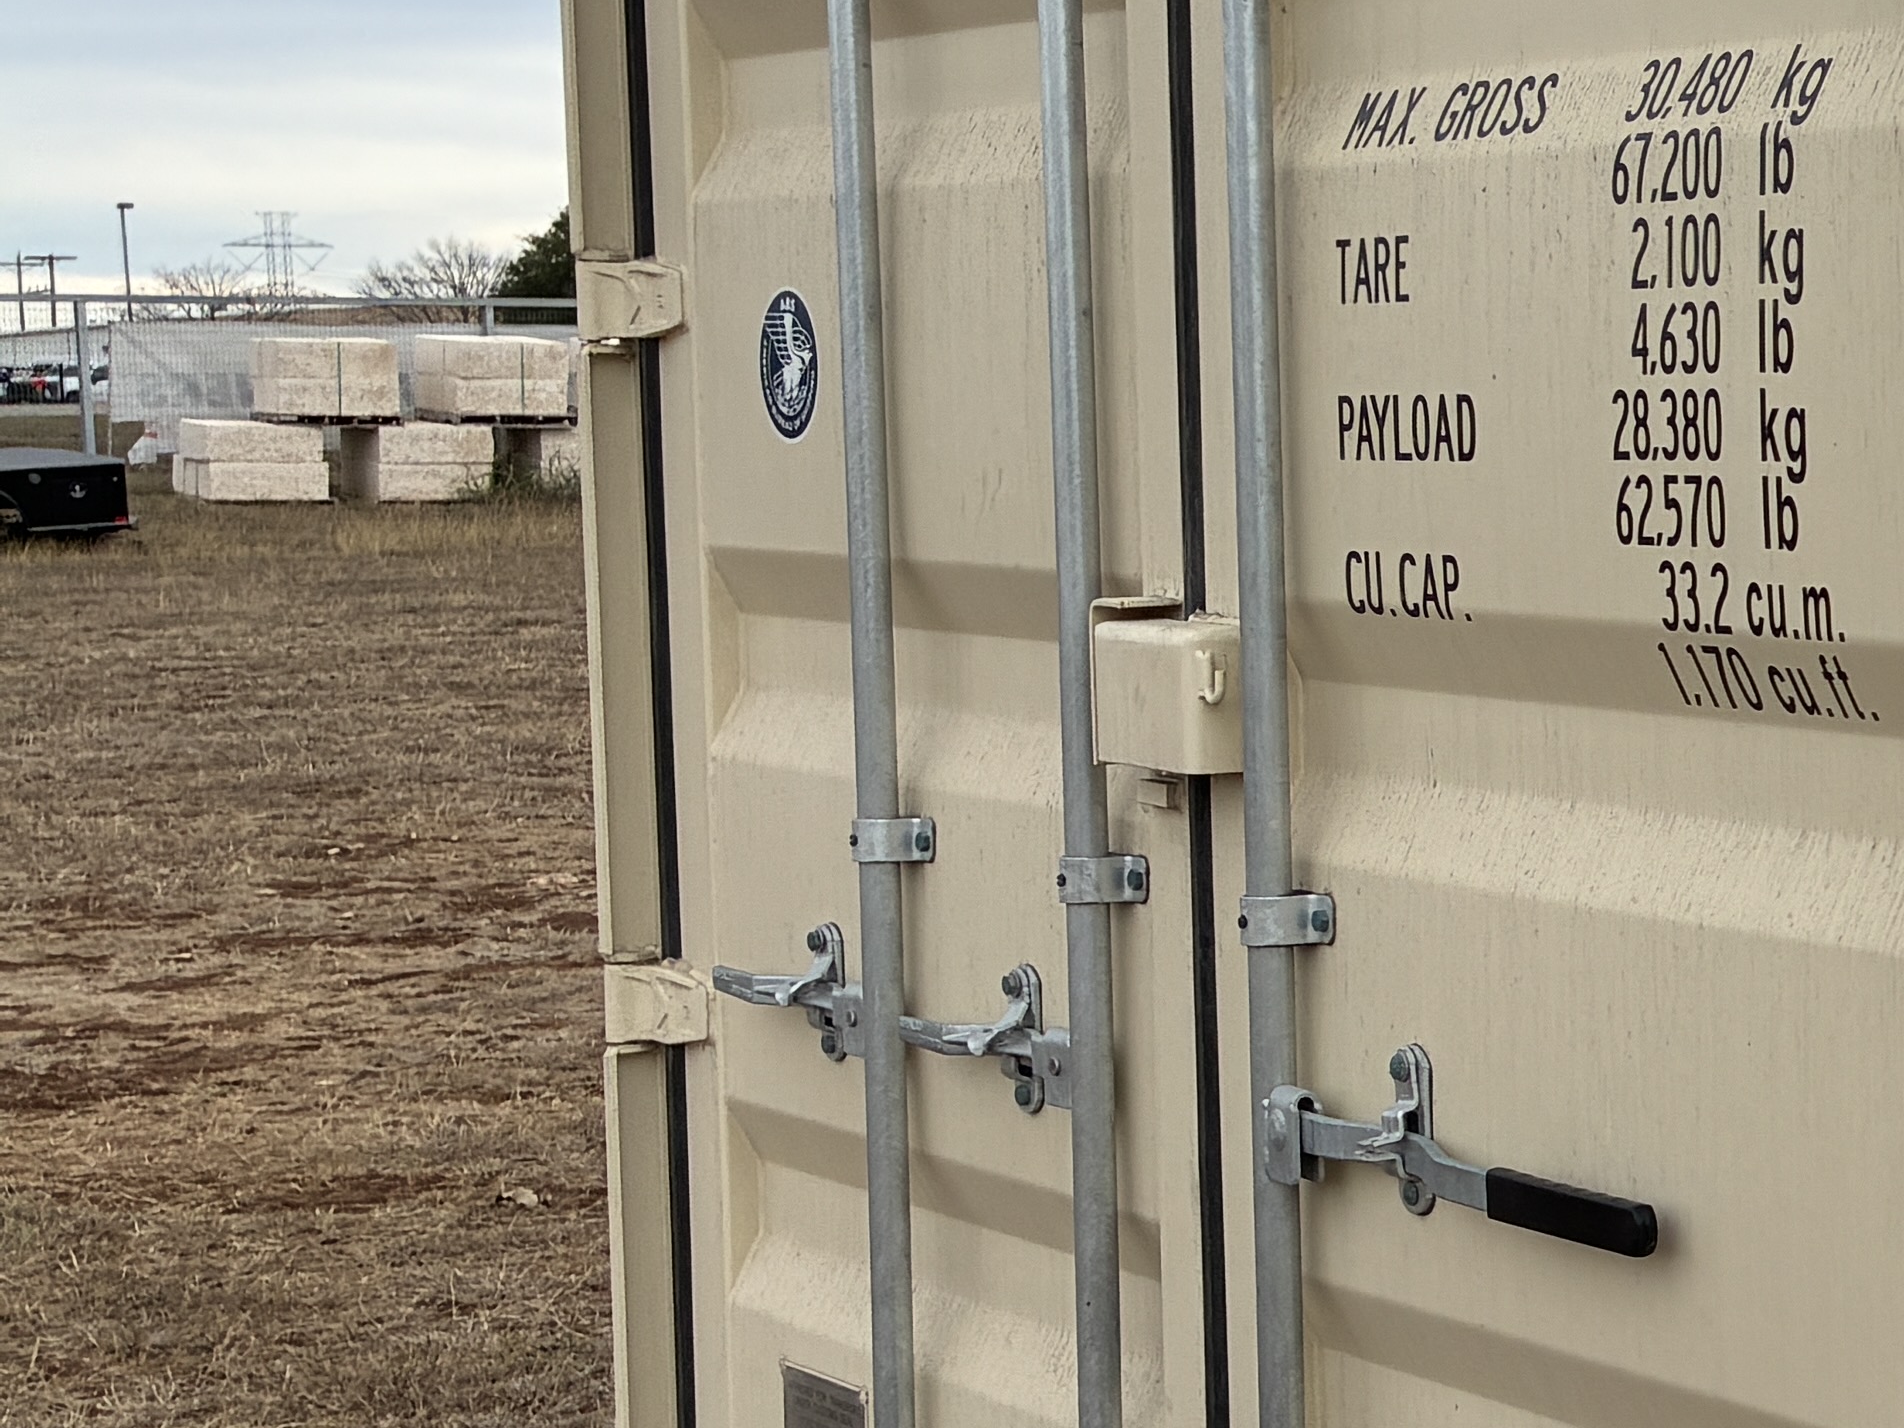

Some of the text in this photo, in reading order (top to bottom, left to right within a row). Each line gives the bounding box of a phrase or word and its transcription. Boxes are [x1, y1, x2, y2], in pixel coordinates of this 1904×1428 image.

[1342, 44, 1833, 150] MAX. GROSS 30,480 kg
[1612, 126, 1794, 204] 67,200 lb
[1336, 210, 1803, 304] TARE 2,100 kg
[1632, 301, 1795, 375] 4,630 lb
[1338, 388, 1806, 482] PAYLOAD 28,380 kg
[1617, 475, 1801, 551] 62,570 lb
[1346, 551, 1845, 642] CU.CAP. 33.2 cu.m.
[1768, 655, 1879, 721] cu.ft.
